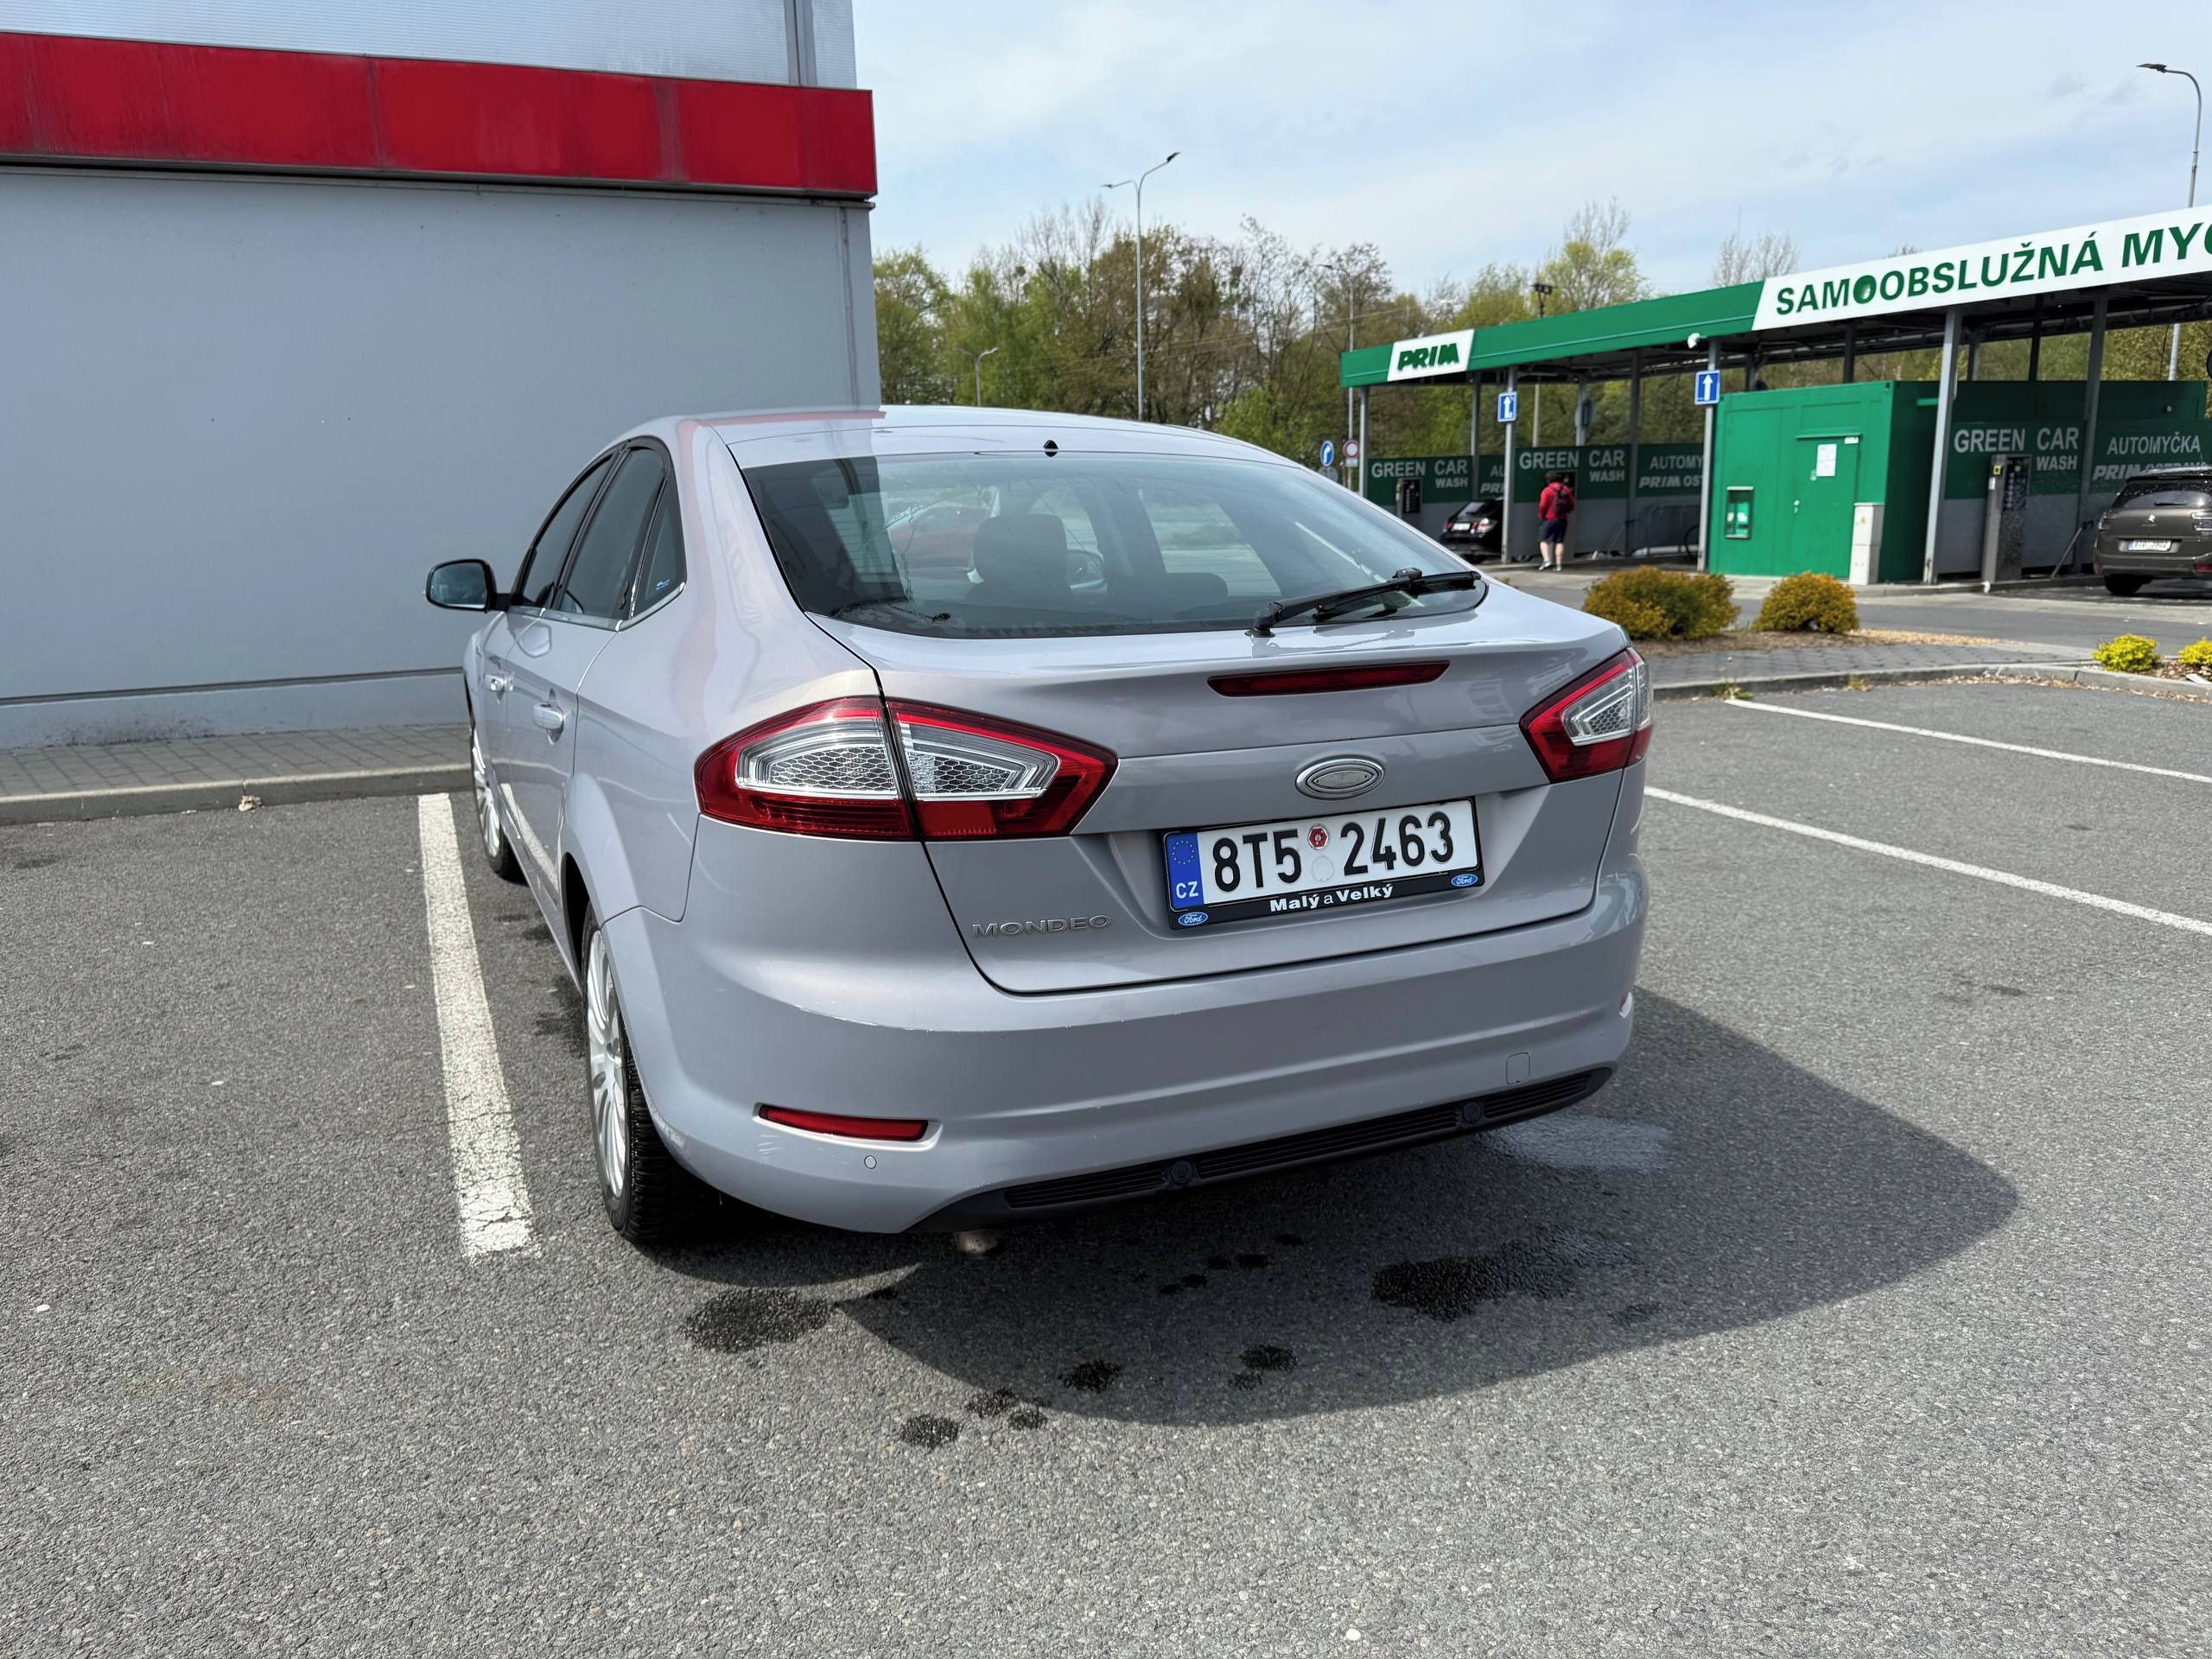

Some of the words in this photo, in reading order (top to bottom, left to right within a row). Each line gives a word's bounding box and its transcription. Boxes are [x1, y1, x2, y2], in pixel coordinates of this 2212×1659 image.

[1776, 231, 2104, 315] SAMOOBSLUŽNÁ
[1397, 342, 1459, 372] PRIM
[1954, 428, 2026, 453] GREEN
[2036, 427, 2079, 450] CAR
[2107, 431, 2201, 455] AUTOMYČKA
[1371, 461, 1426, 478] GREEN
[1434, 459, 1468, 475] CAR
[1519, 450, 1580, 469] GREEN
[1589, 449, 1624, 467] CAR
[1649, 454, 1703, 470] AUTOMY
[2037, 455, 2078, 471] WASH
[1434, 477, 1468, 489] WASH
[1590, 470, 1624, 482] WASH
[1638, 475, 1681, 488] PRIM
[1212, 829, 1302, 892] 8T5
[1340, 811, 1453, 876] 2463
[1175, 880, 1199, 899] CZ
[1454, 875, 1474, 886] Ford
[1270, 893, 1319, 912] Malý
[1323, 894, 1334, 905] a
[1336, 883, 1393, 902] Velký
[972, 914, 1112, 938] MONDEO
[1181, 913, 1205, 924] Ford
